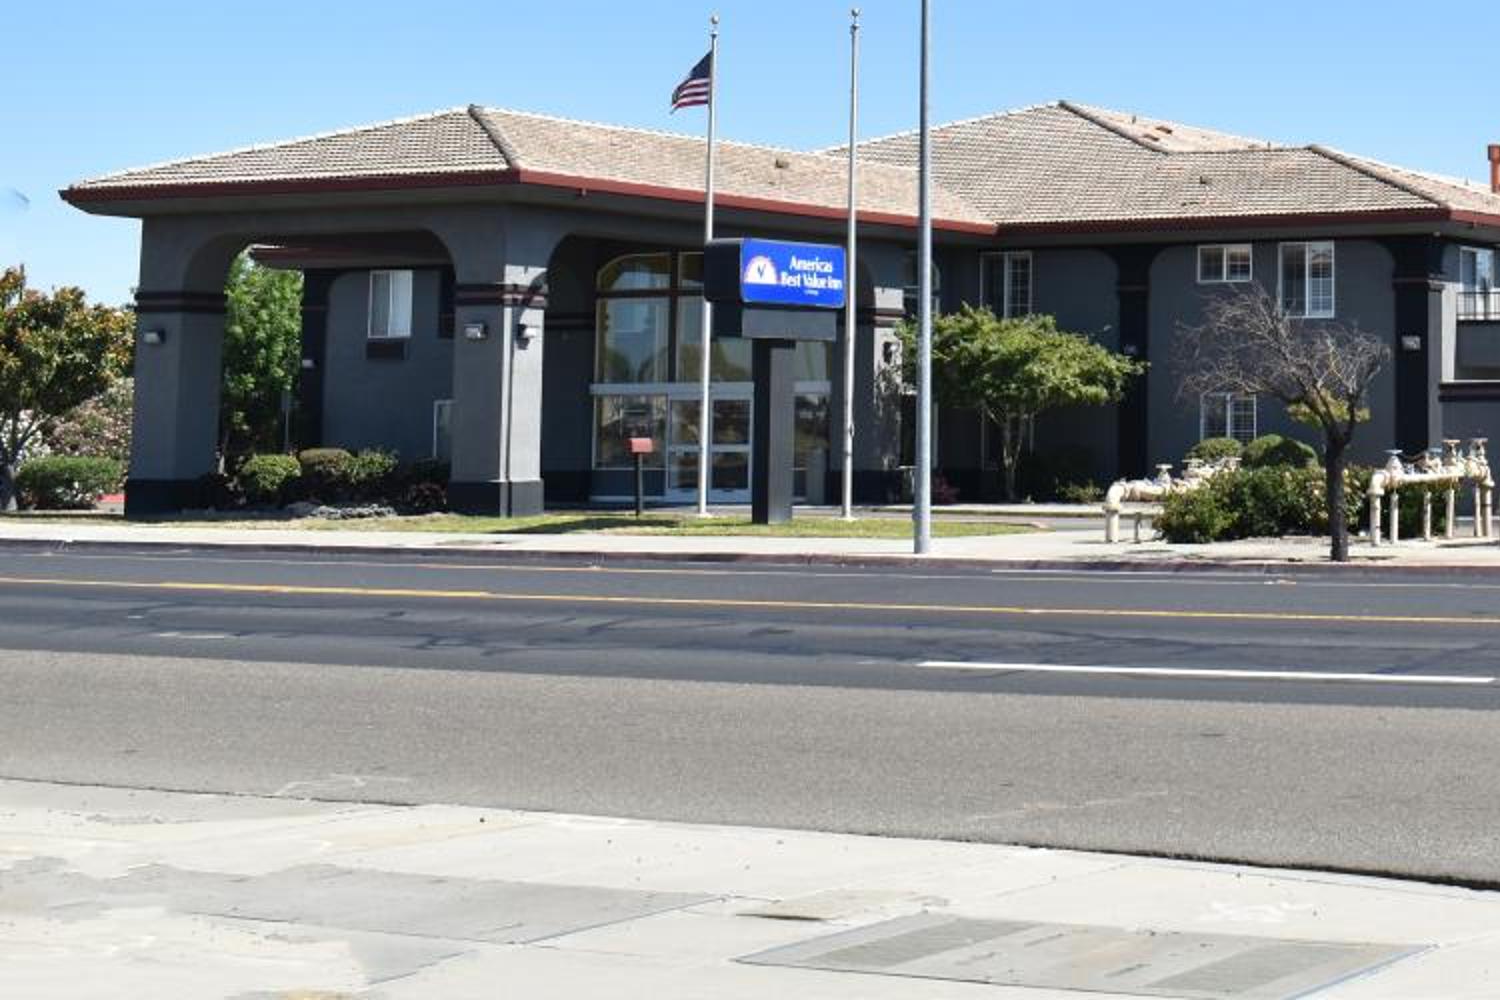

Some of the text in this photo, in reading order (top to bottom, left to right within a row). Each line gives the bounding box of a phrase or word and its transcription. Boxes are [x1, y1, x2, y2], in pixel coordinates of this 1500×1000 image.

[790, 255, 833, 273] Americas
[781, 271, 843, 290] Best Value Inn
